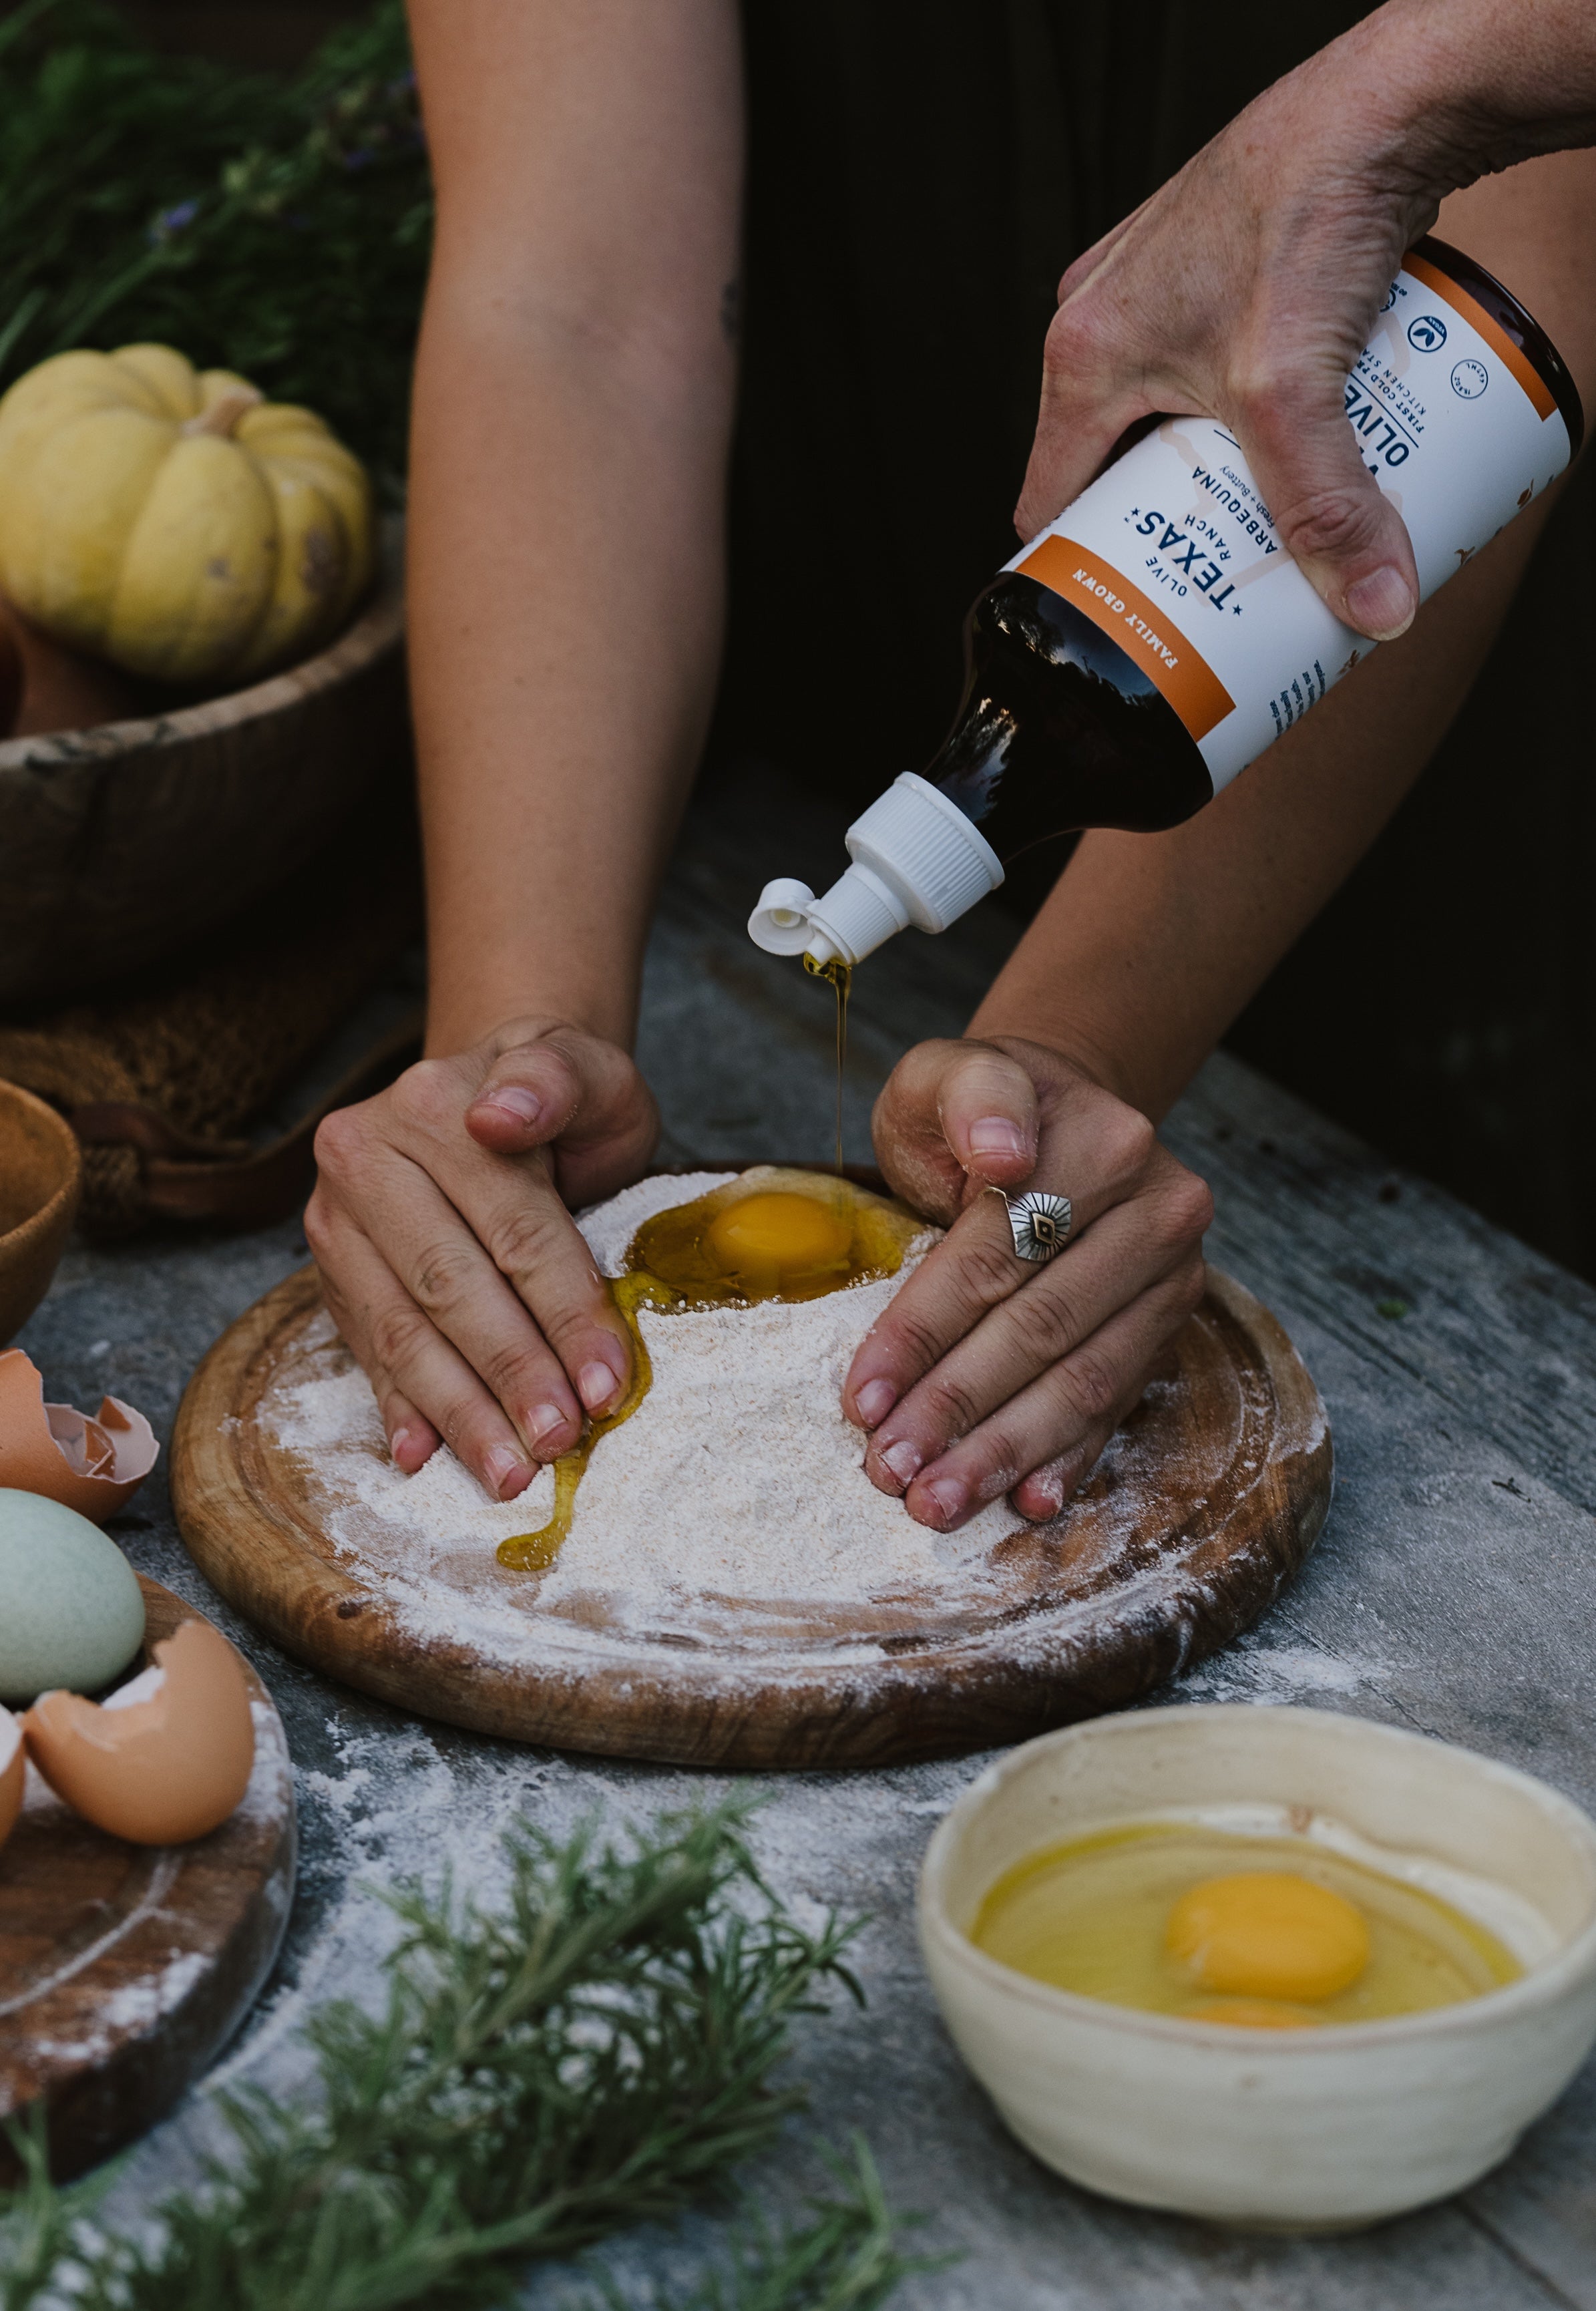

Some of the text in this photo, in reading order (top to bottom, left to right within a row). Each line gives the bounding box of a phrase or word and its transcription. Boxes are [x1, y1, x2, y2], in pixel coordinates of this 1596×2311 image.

[1429, 316, 1444, 334] VEGAN
[1356, 361, 1424, 433] FIRST COLD PR
[1362, 347, 1426, 415] KITCHEN STA
[1220, 466, 1250, 497] Buttery
[1193, 466, 1277, 554] ARBEQUINA
[1256, 502, 1275, 528] Fresh
[1185, 515, 1231, 560] RANCH
[1136, 512, 1235, 611] TEXAS
[1146, 557, 1187, 596] OLIVE
[1072, 569, 1178, 669] FAMILY GROWN
[1270, 700, 1279, 718] close
[1281, 691, 1291, 712] family
[1291, 679, 1303, 703] South.
